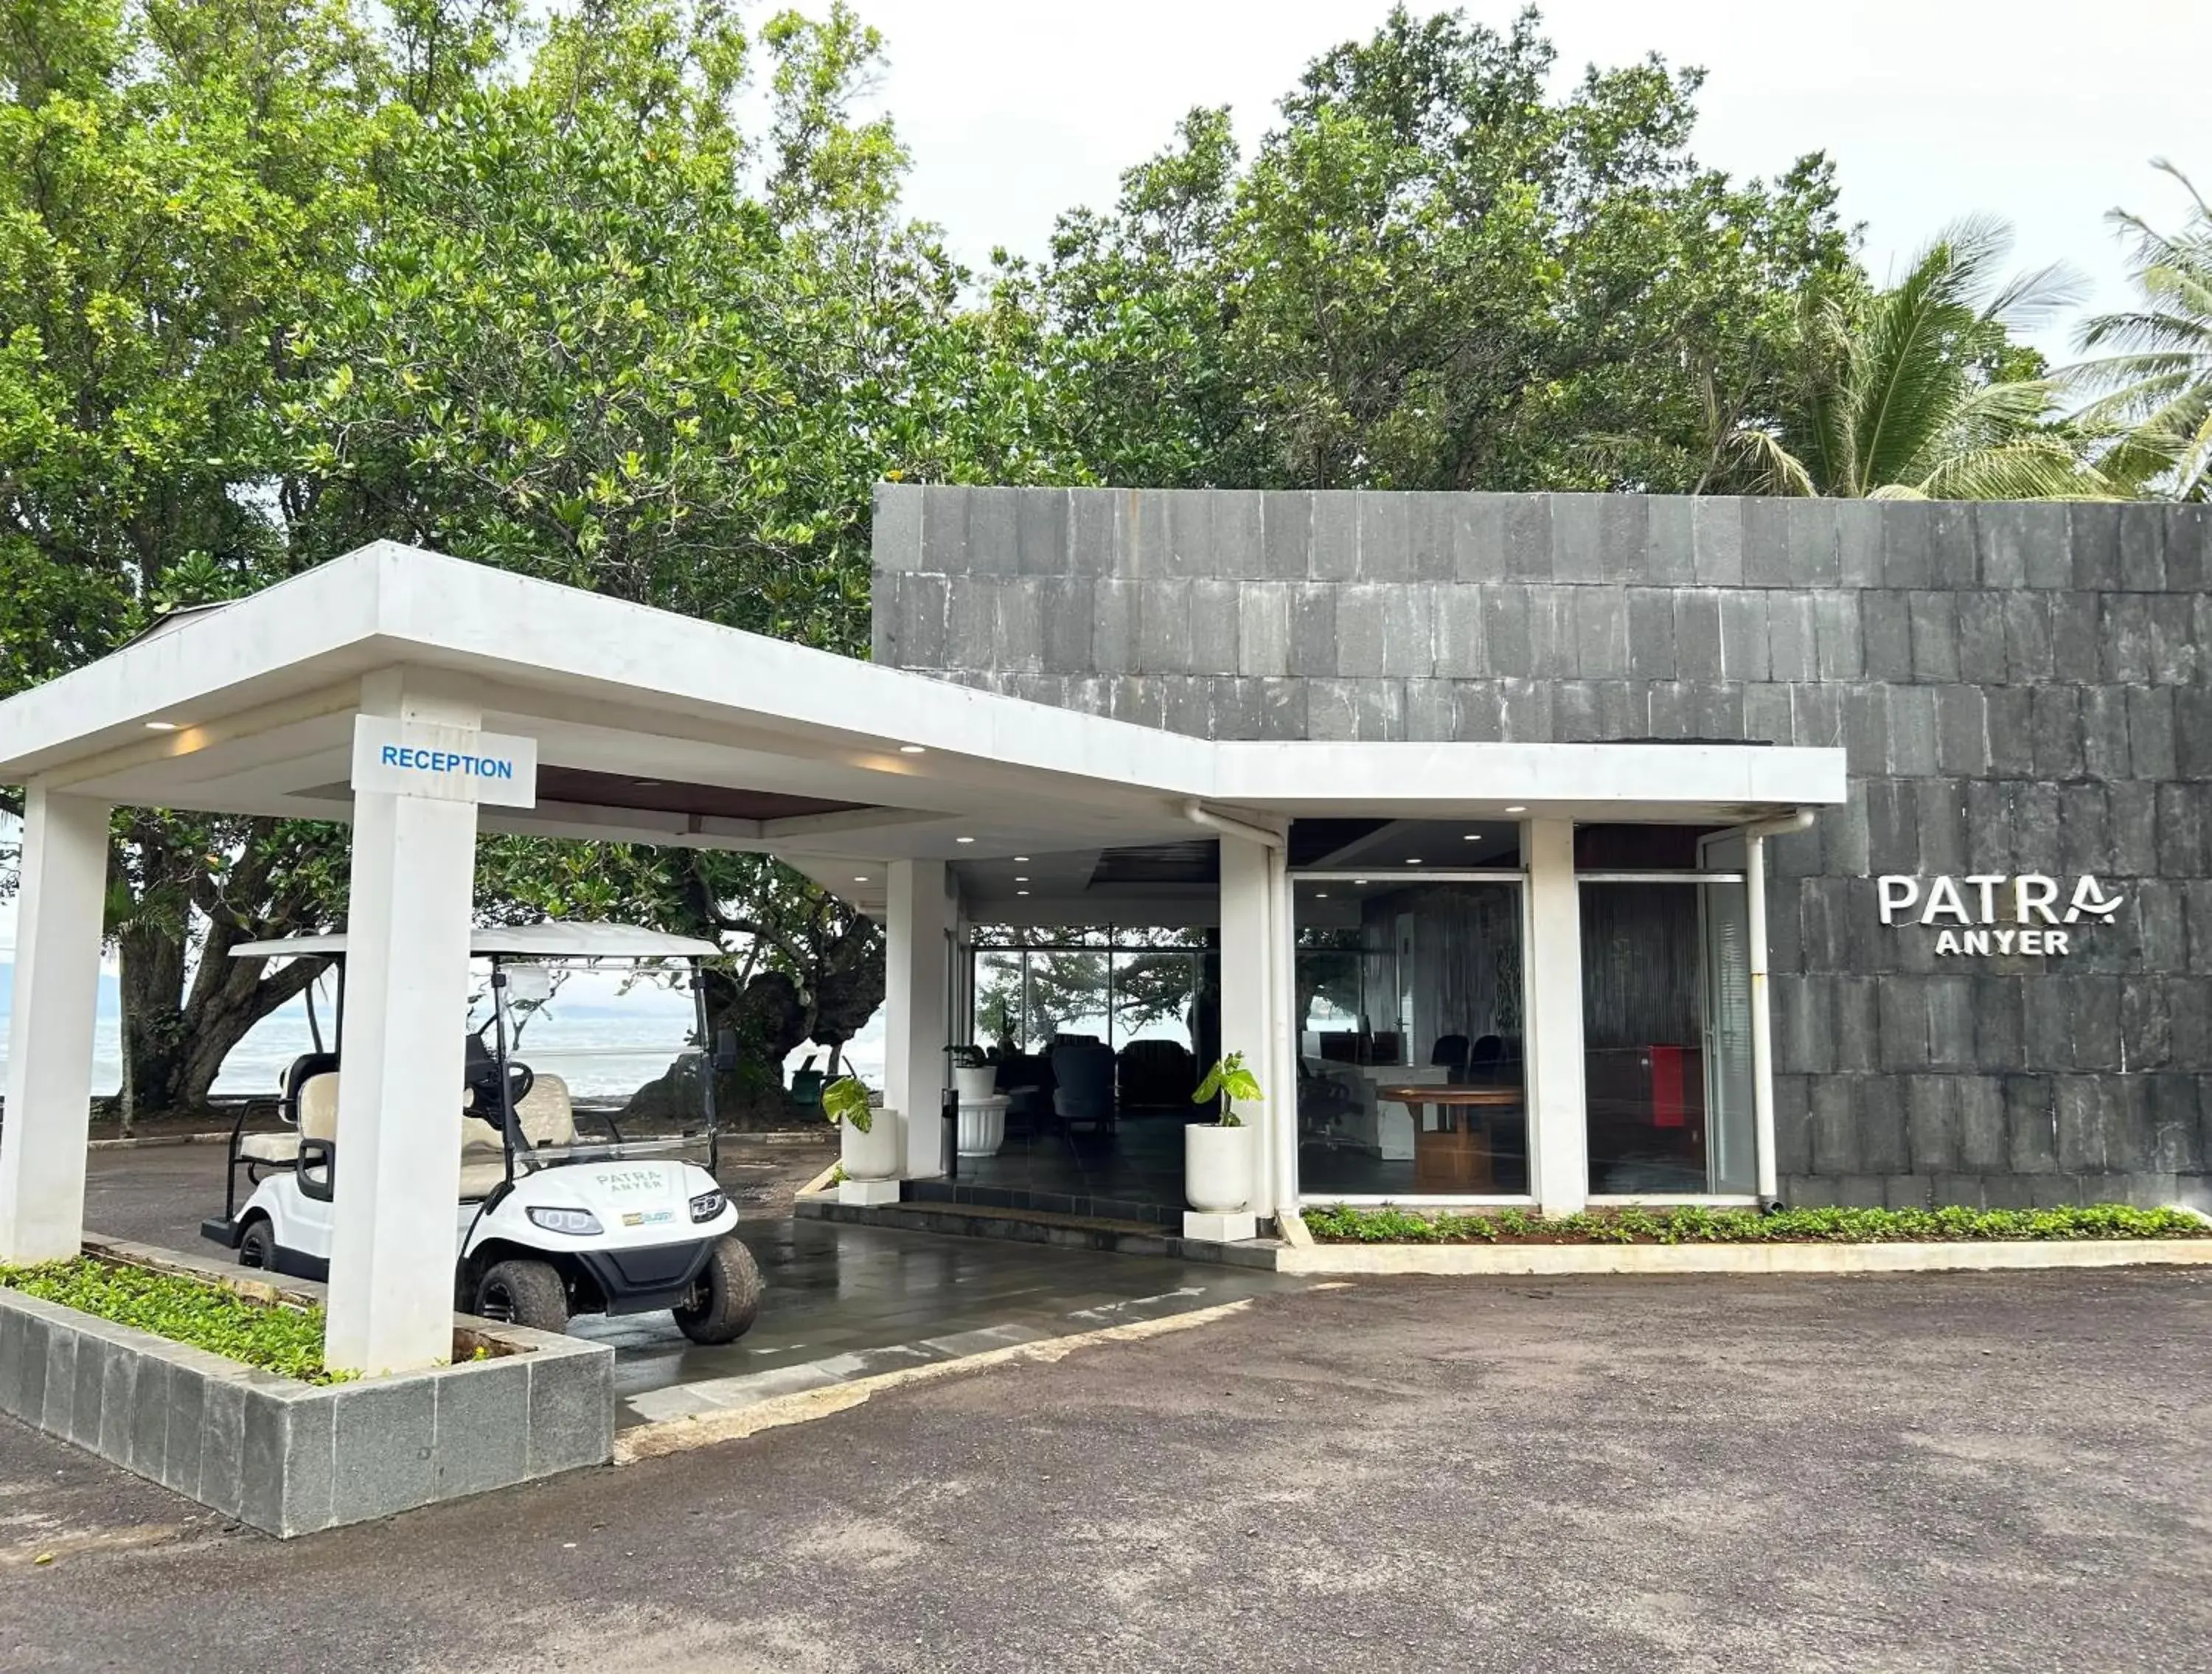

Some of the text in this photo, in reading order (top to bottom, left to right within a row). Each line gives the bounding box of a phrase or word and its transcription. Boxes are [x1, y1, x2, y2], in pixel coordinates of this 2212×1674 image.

[382, 746, 512, 779] RECEPTION
[1877, 875, 2124, 924] PATRA
[1935, 930, 2069, 955] ANYER
[596, 1171, 661, 1185] PATRA
[611, 1181, 661, 1192] ANYER
